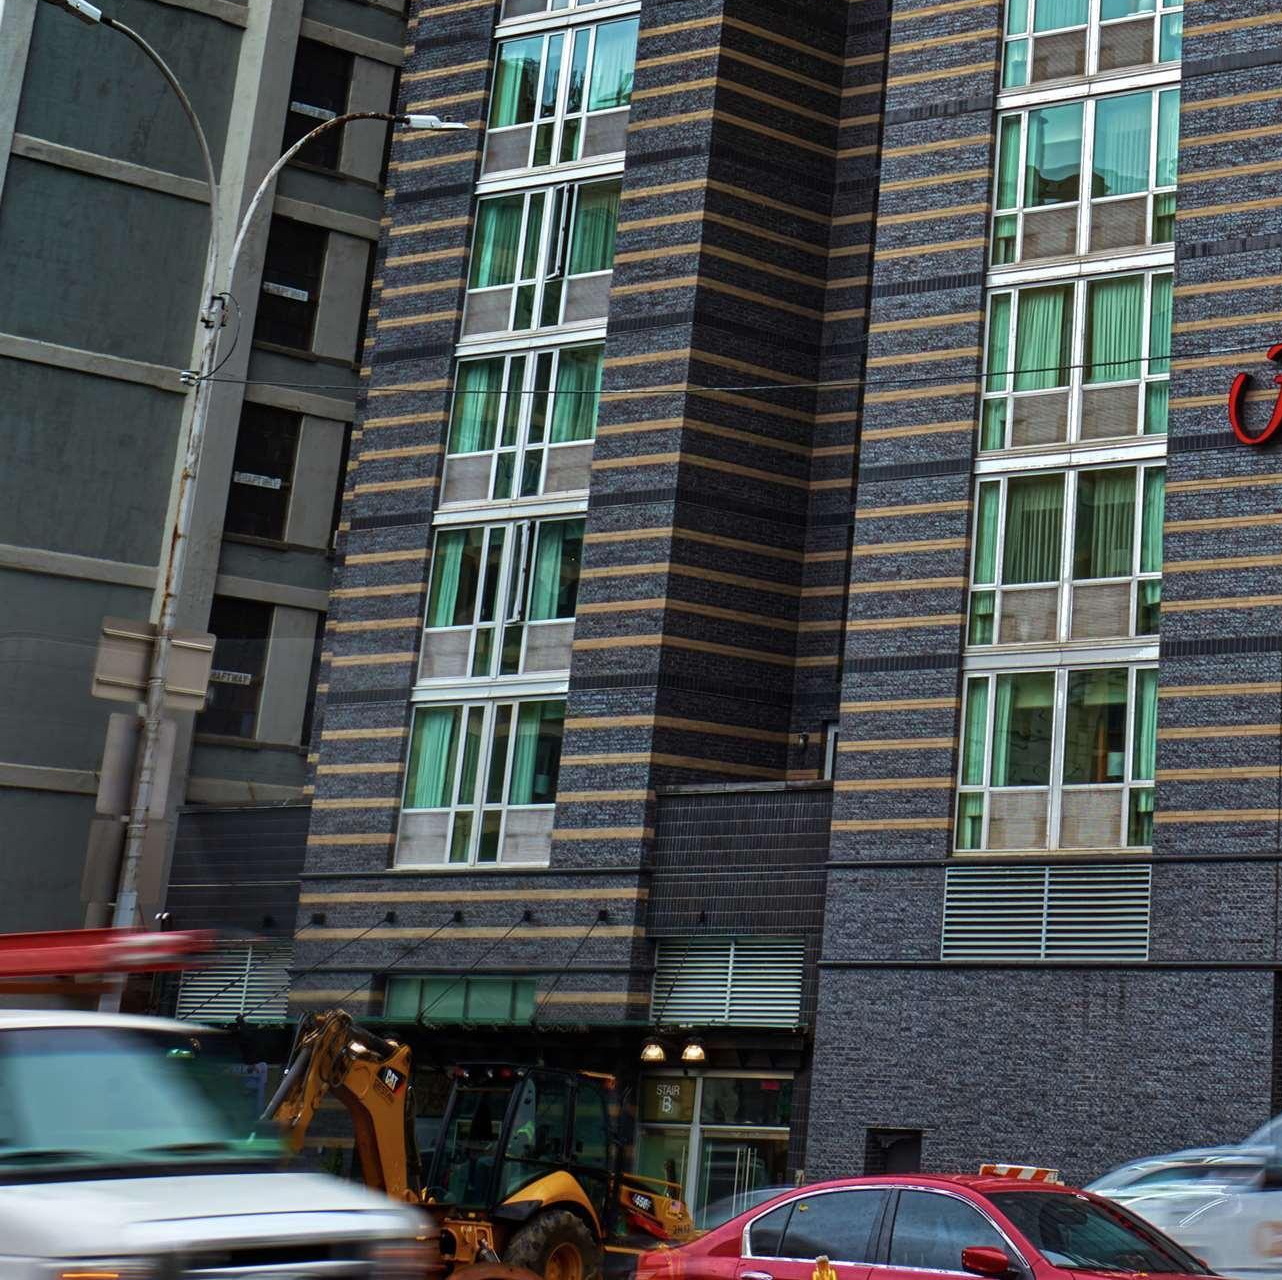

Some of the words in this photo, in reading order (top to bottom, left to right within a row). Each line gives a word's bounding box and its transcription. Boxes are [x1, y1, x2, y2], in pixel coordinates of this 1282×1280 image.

[384, 1069, 399, 1091] CAT
[656, 1084, 681, 1096] STAIR
[662, 1095, 673, 1113] B
